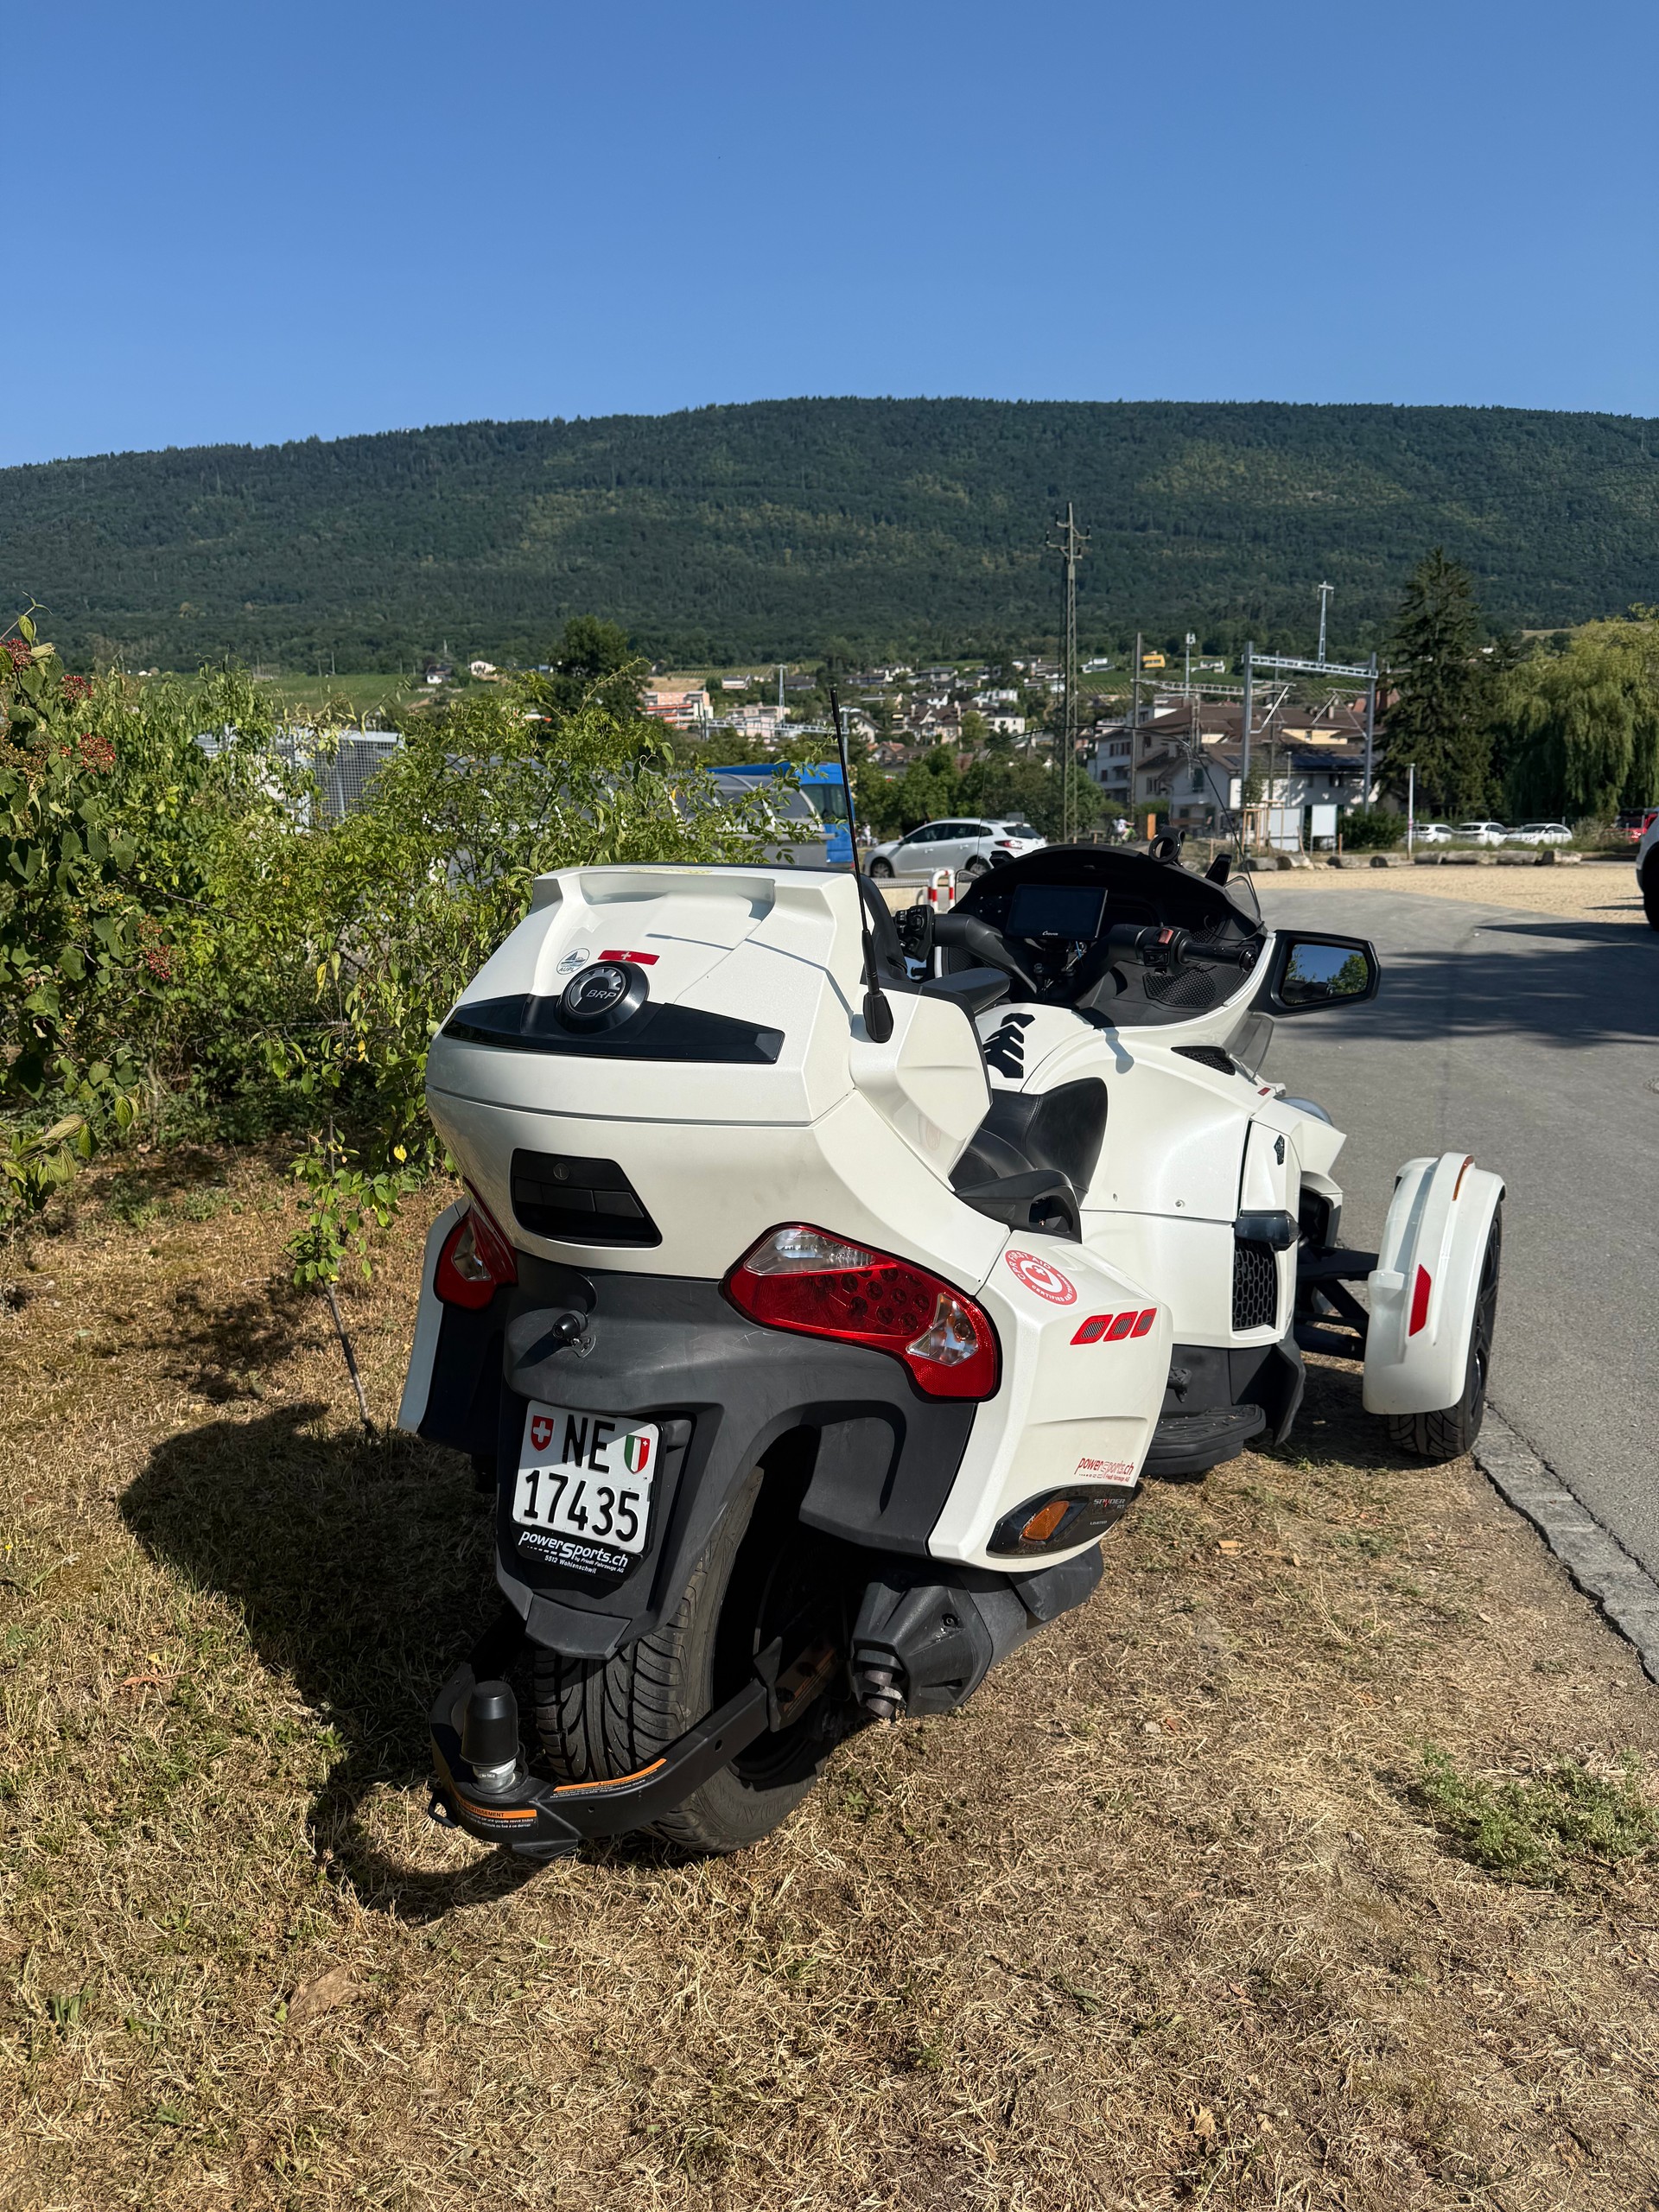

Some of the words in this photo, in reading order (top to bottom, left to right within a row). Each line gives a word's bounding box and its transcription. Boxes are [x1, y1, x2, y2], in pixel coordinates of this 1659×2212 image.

[587, 989, 617, 999] BRP
[1007, 1252, 1029, 1262] FIRST
[1033, 1257, 1051, 1269] AID
[1009, 1262, 1027, 1280] CPR
[563, 1414, 615, 1474] NE
[524, 1470, 640, 1542] 17435
[1093, 1498, 1126, 1508] SPYDER
[544, 1554, 558, 1563] 5512
[559, 1559, 597, 1574] Wohlenschwil
